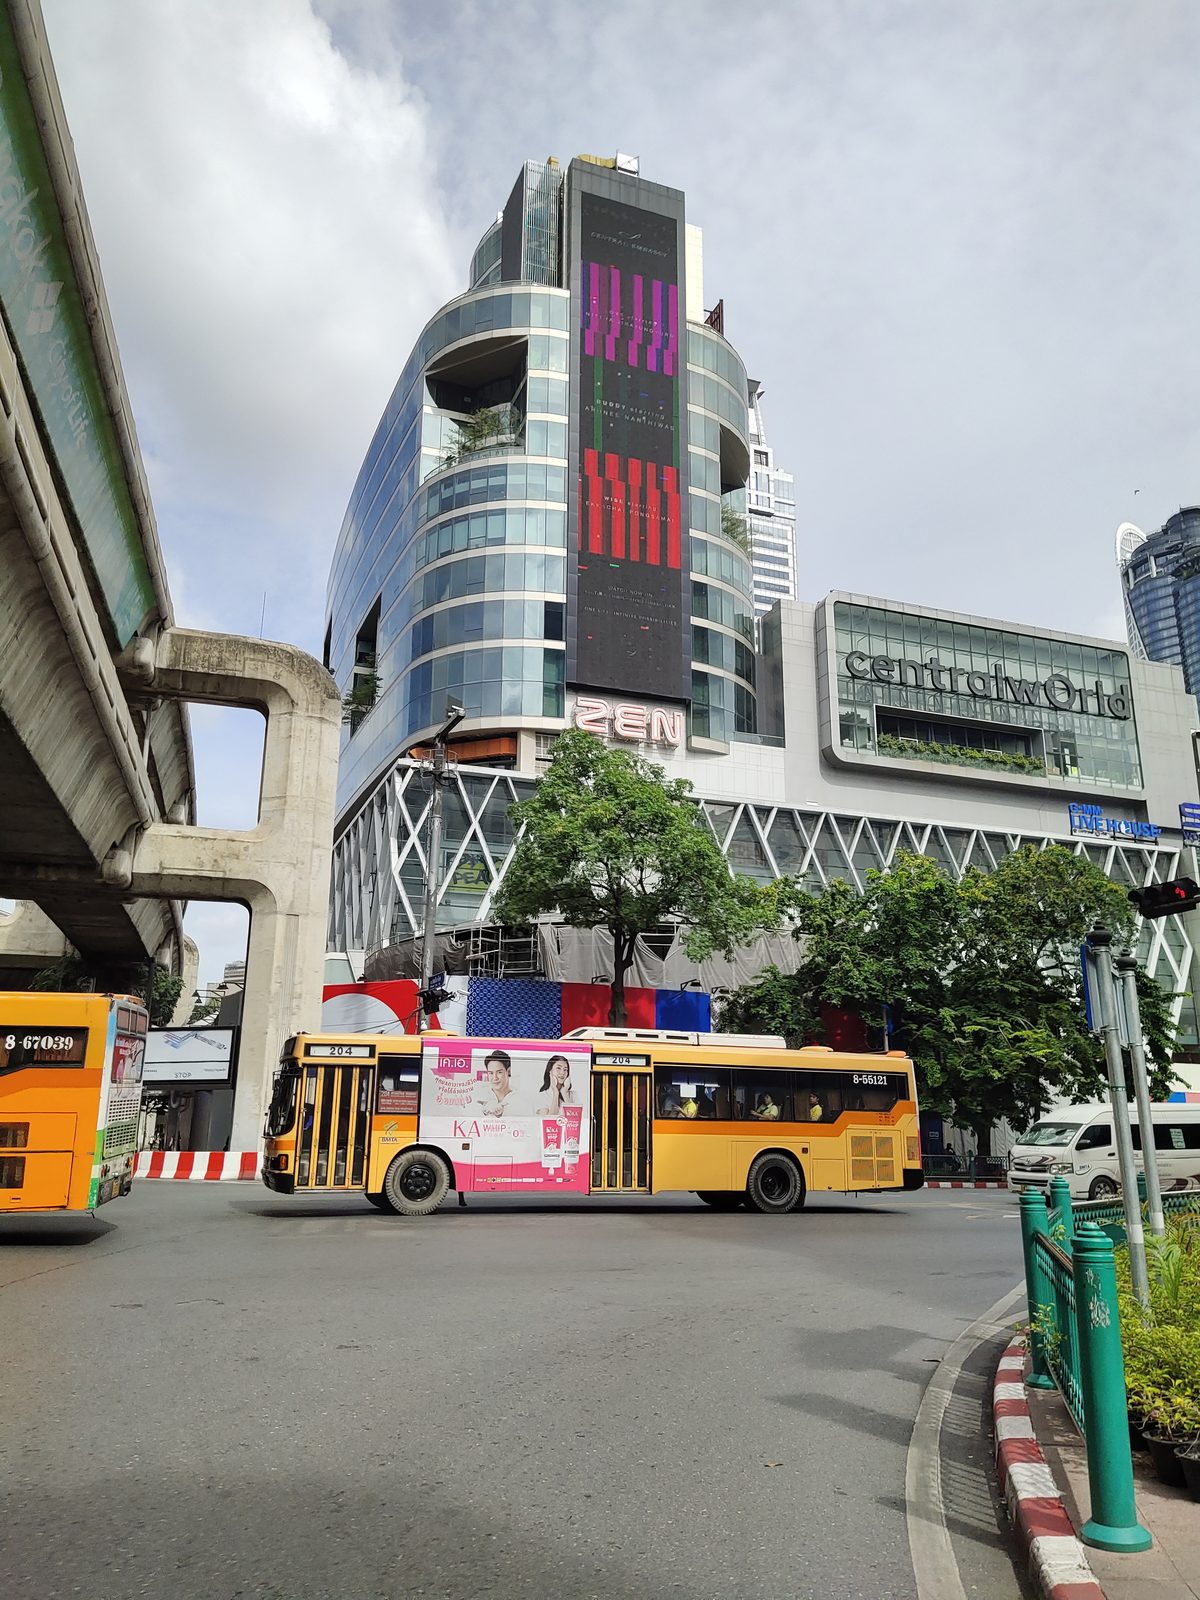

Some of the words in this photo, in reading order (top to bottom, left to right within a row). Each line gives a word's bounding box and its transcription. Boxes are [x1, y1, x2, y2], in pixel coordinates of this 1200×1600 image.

[575, 696, 683, 743] ZEN
[1071, 814, 1104, 832] LIVE
[4, 1035, 74, 1051] 8-67039
[329, 1046, 354, 1056] 204
[611, 1056, 632, 1065] 204
[852, 1074, 888, 1085] 8-55121
[453, 1119, 481, 1138] KA
[482, 1124, 507, 1132] WHIP
